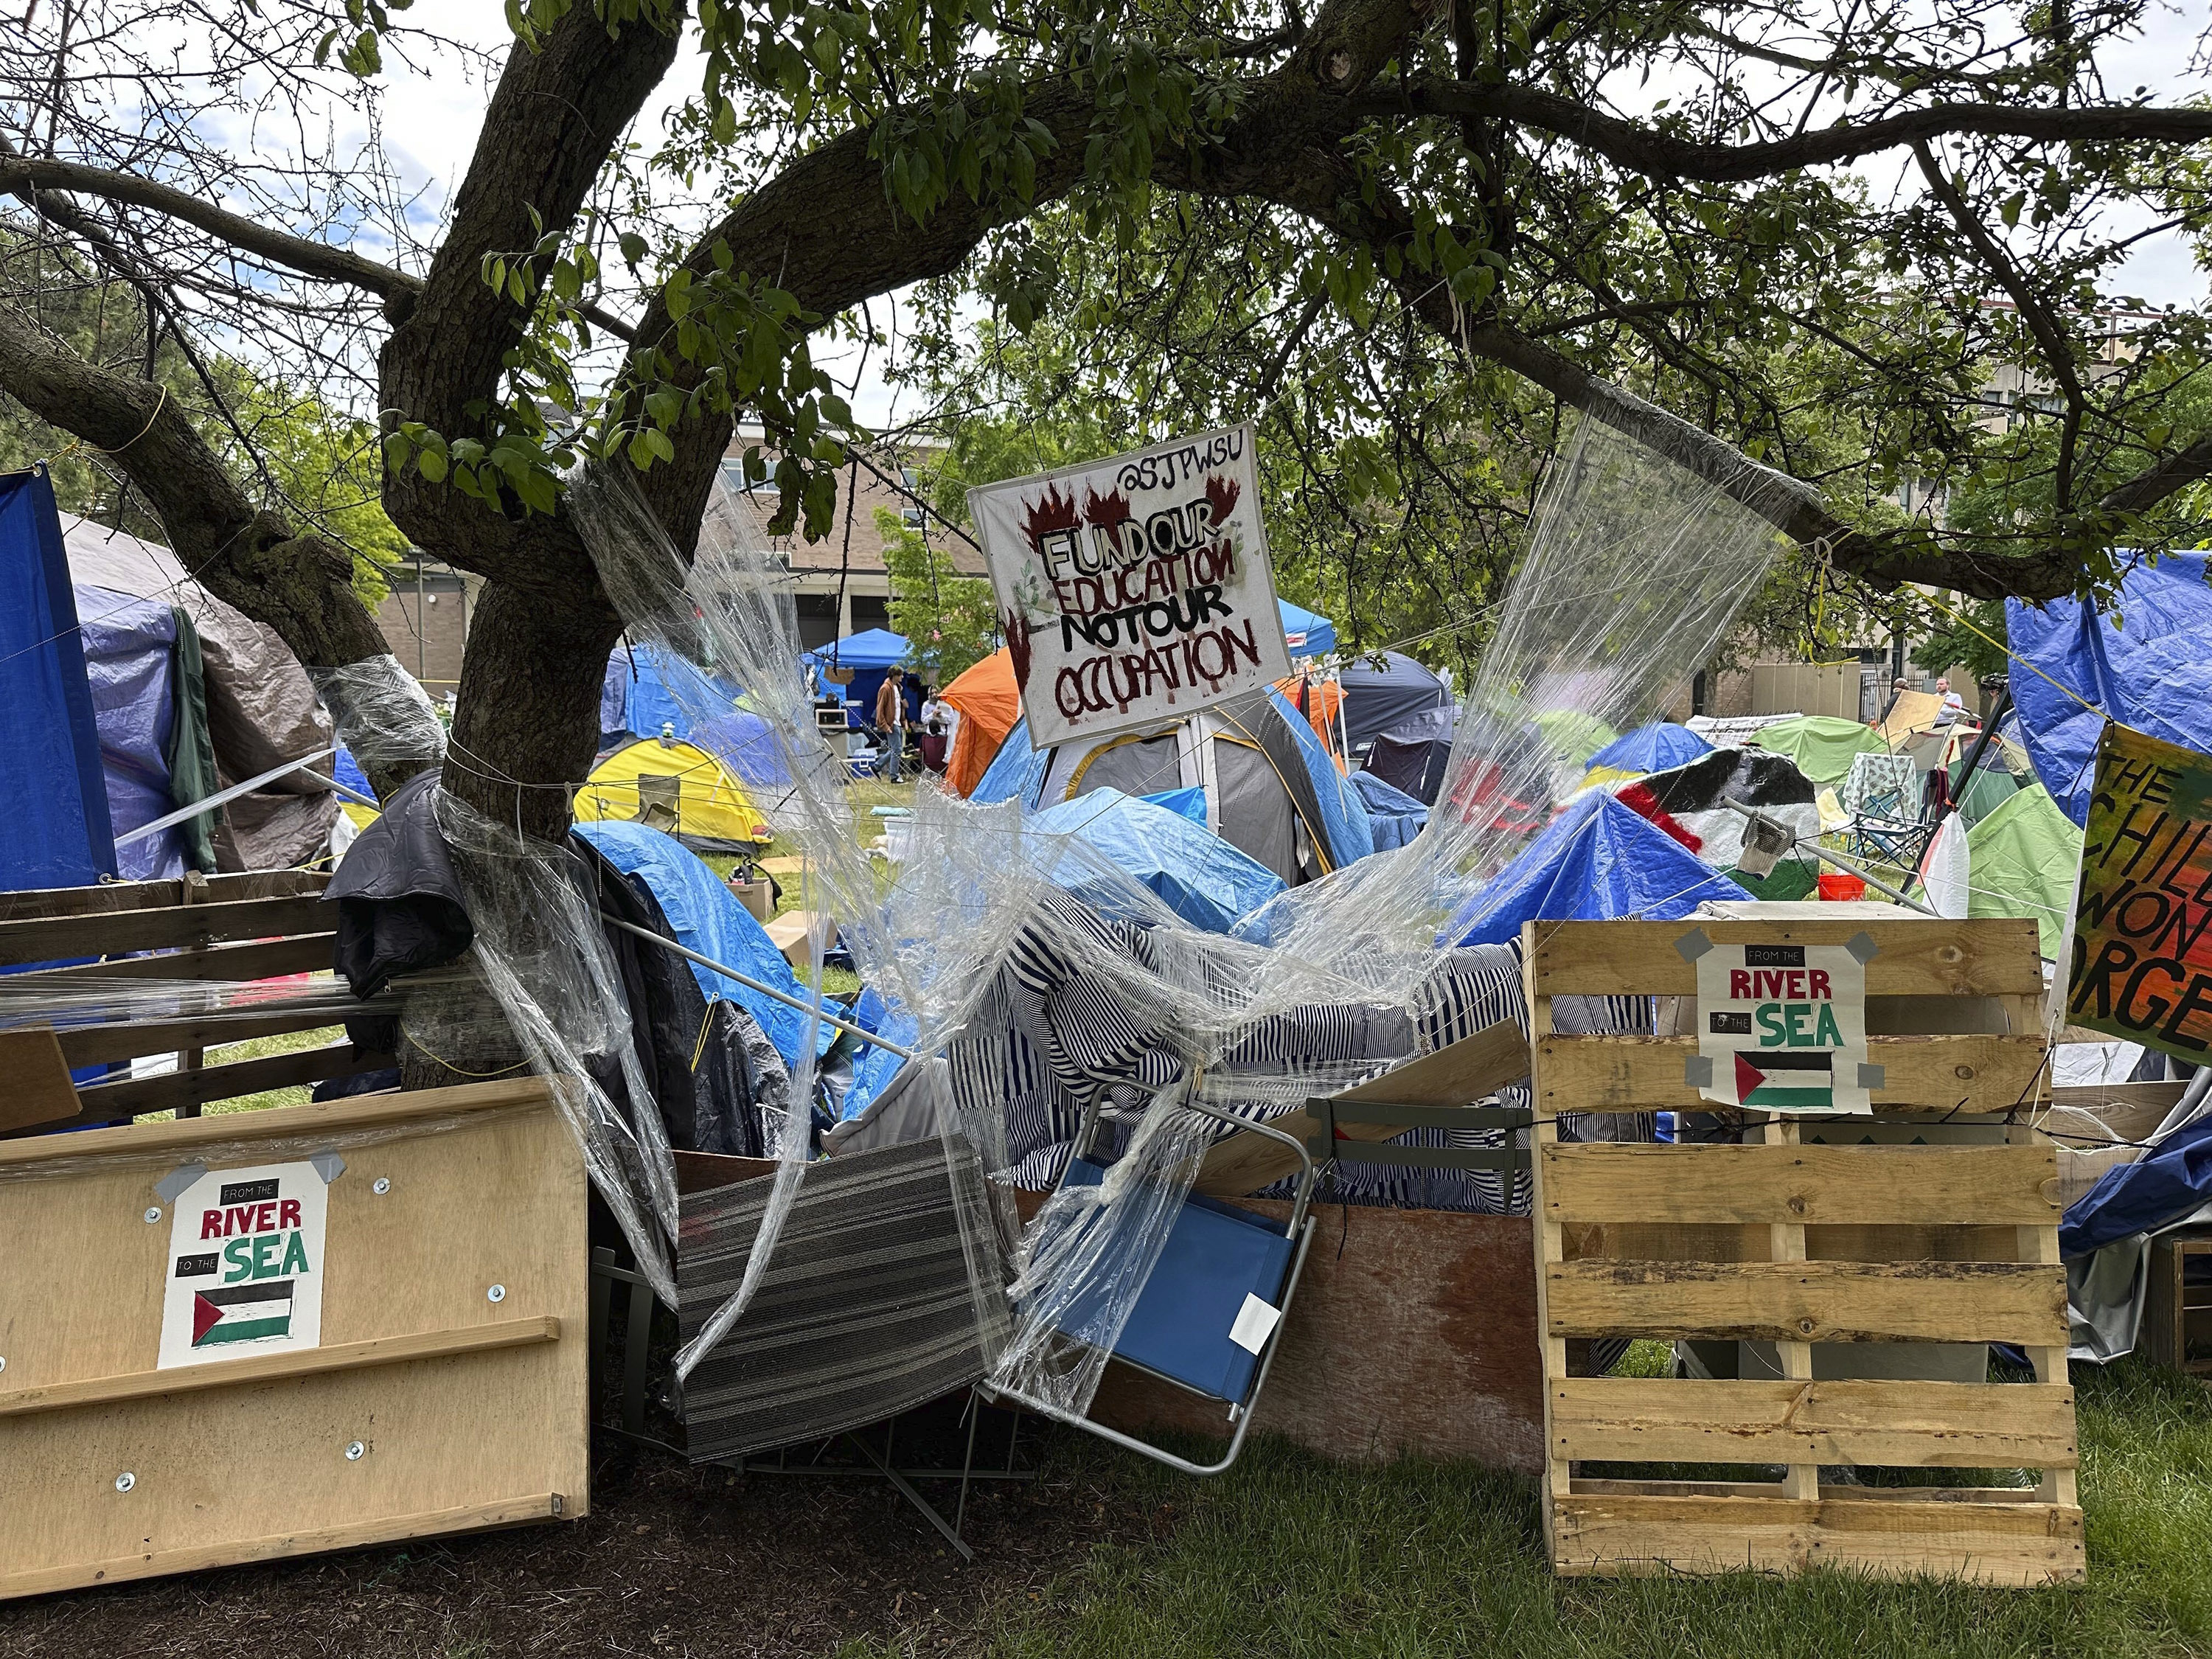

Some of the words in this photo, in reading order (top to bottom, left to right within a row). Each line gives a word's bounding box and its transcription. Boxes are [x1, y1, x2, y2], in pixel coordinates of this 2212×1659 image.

[1117, 429, 1243, 491] @SJPWSU
[1038, 518, 1150, 581] FUND
[1146, 498, 1222, 557] OUR
[1053, 538, 1237, 616] EDUCATION
[1060, 603, 1147, 653] NOT
[1142, 584, 1234, 634] OUR
[1054, 618, 1262, 718] OCCUPATION
[2098, 752, 2184, 805] THE
[2076, 868, 2212, 961] WON
[1748, 950, 1778, 961] FROM
[1783, 950, 1799, 961] THE
[1730, 968, 1832, 1000] RIVER
[1711, 1017, 1727, 1027] TO
[1730, 1018, 1749, 1029] THE
[1755, 1002, 1846, 1048] SEA
[223, 1187, 254, 1199] FROM
[257, 1184, 273, 1195] THE
[199, 1199, 302, 1240] RIVER
[178, 1260, 192, 1270] TO
[198, 1258, 216, 1269] THE
[223, 1231, 310, 1283] SEA
